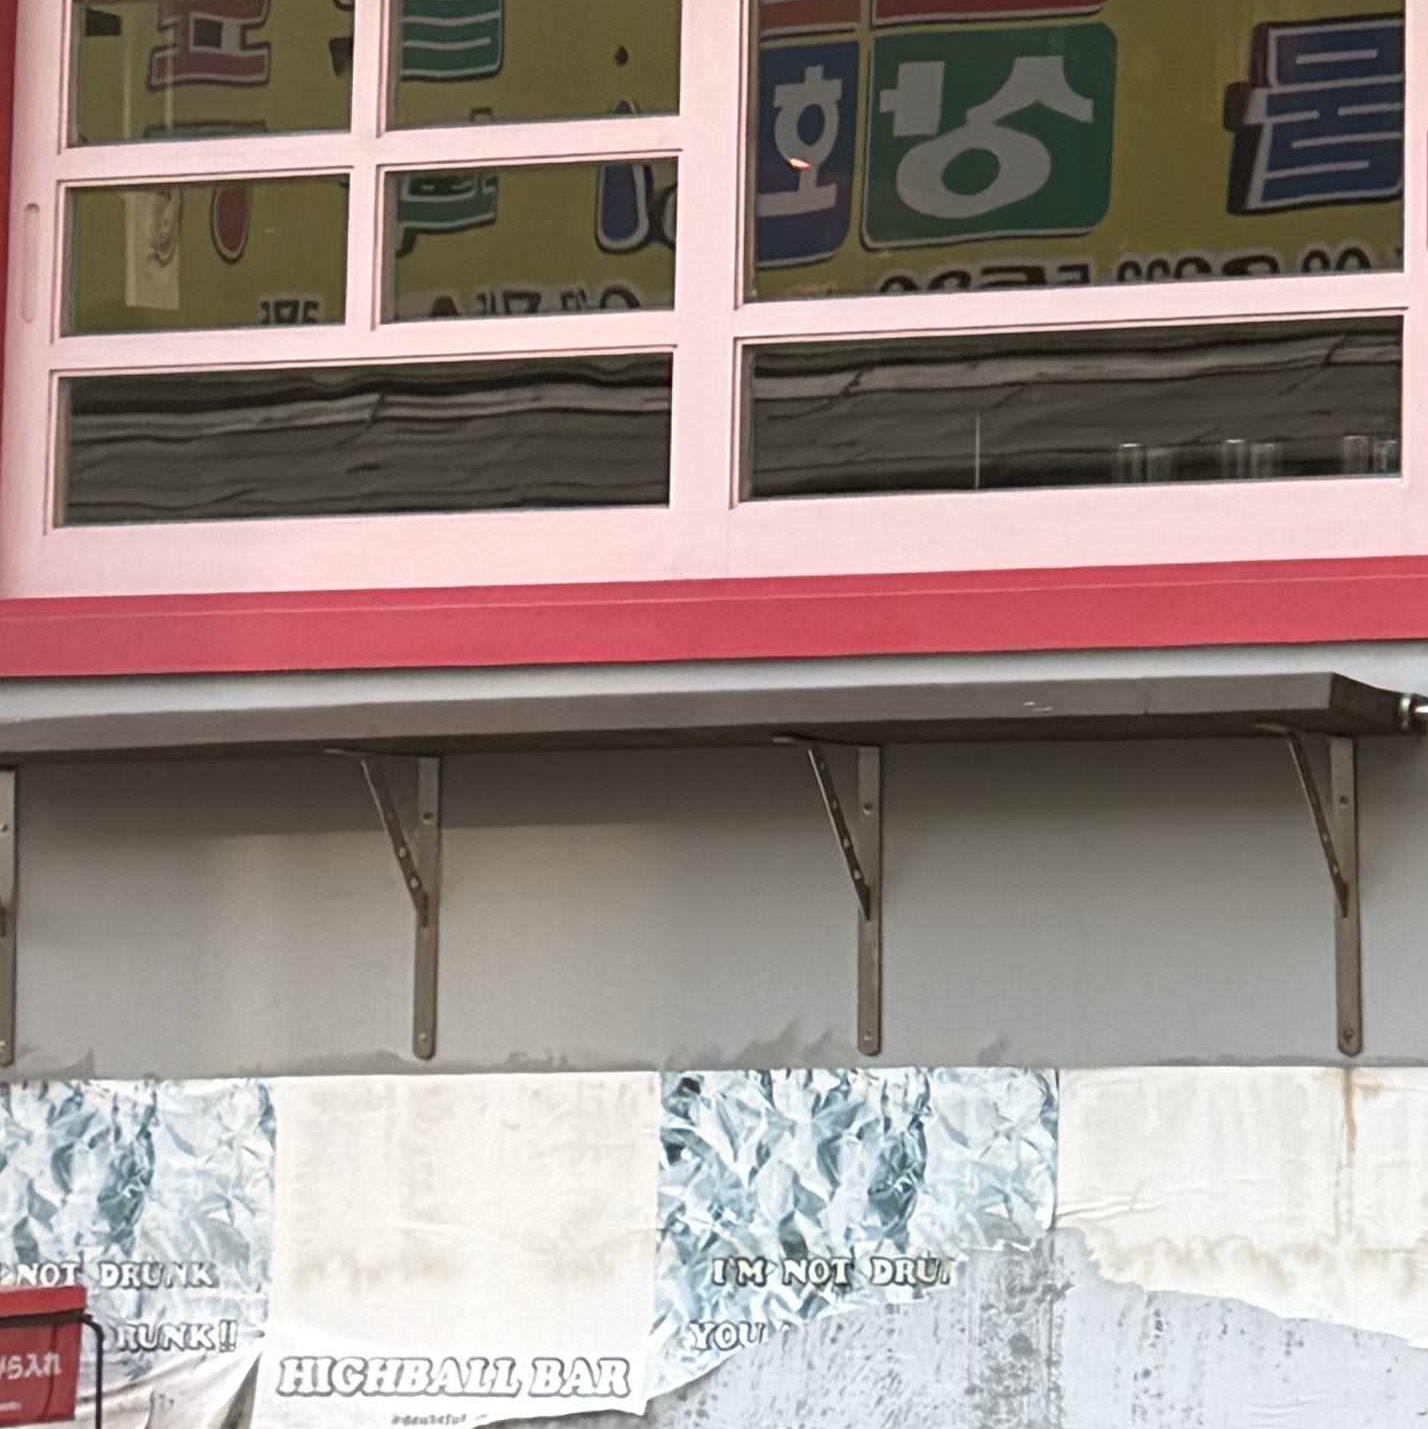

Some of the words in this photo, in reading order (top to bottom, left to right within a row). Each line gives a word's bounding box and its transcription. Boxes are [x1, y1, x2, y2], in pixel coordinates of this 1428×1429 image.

[16, 1261, 82, 1286] NOT
[98, 1260, 219, 1290] DRUNK
[711, 1256, 769, 1286] I'M
[782, 1256, 853, 1286] NOT
[276, 1356, 523, 1398] HIGHBALL
[528, 1356, 631, 1399] BAR
